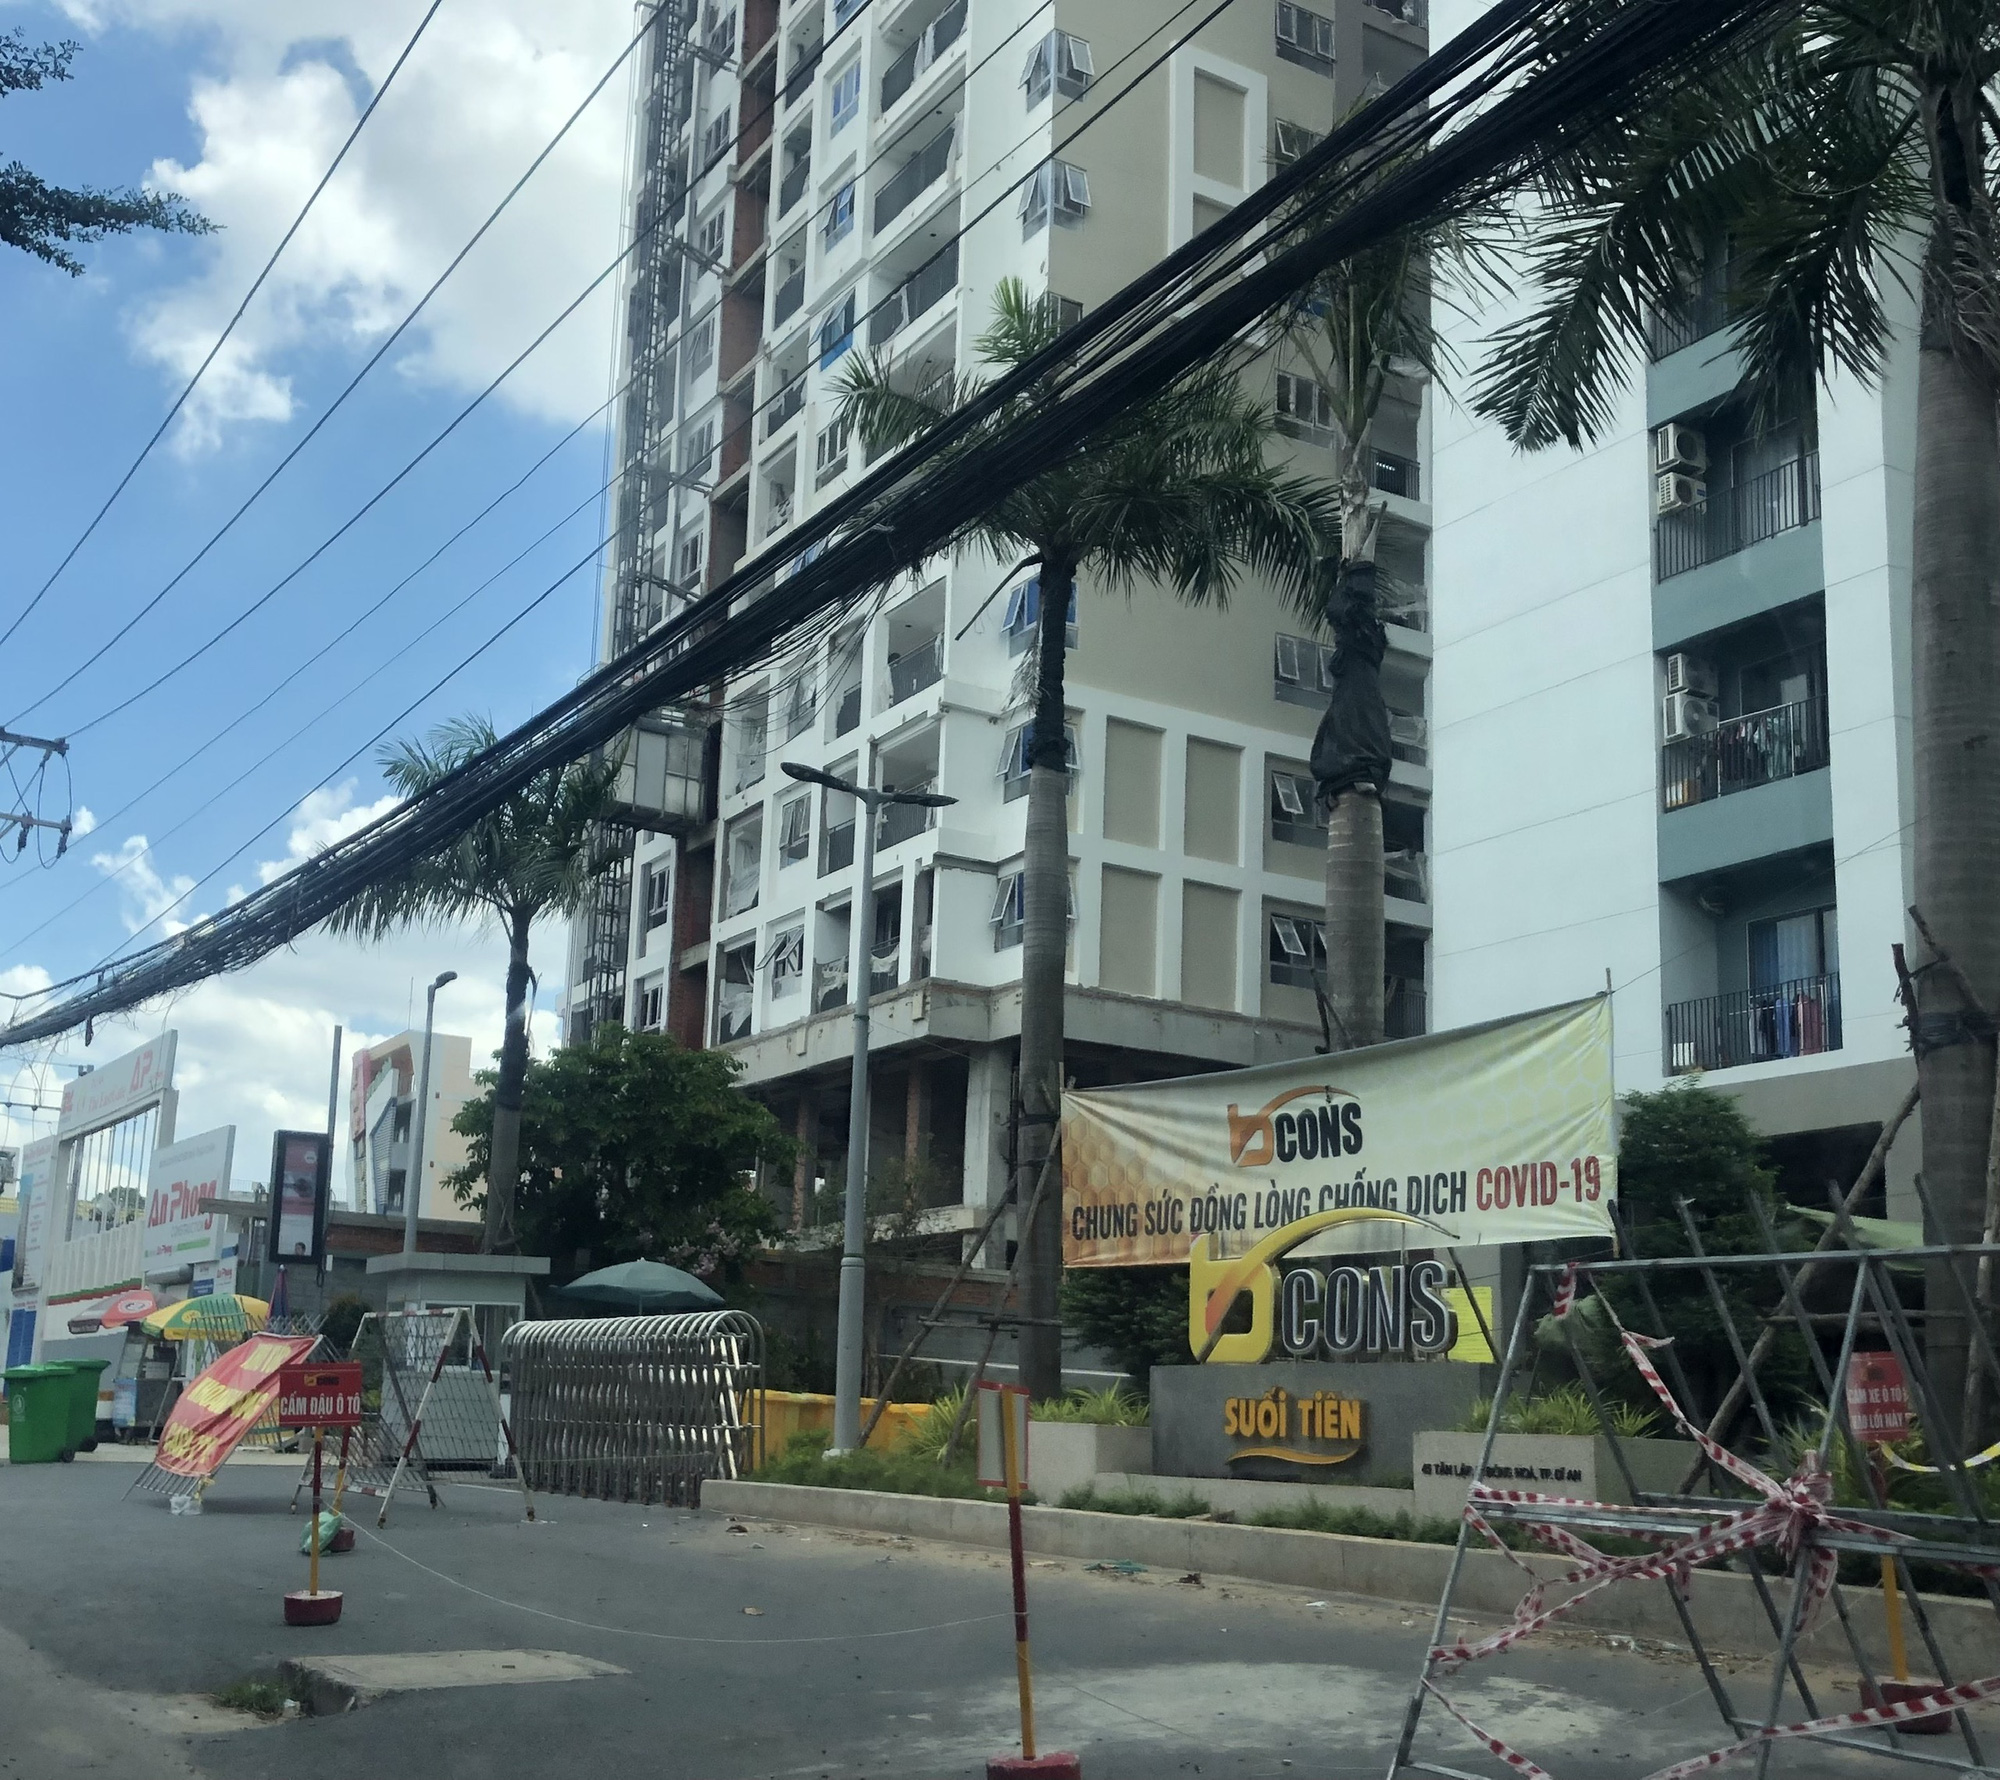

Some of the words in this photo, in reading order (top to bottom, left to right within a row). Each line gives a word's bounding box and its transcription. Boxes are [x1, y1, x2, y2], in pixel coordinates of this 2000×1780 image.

[1072, 1202, 1138, 1241] CHUNG
[1144, 1188, 1184, 1236] SỨC
[1190, 1182, 1248, 1234] ĐỒNG
[1254, 1179, 1311, 1229] LÒNG
[1318, 1167, 1398, 1212] CHỐNG
[1476, 1155, 1601, 1211] COVID-19
[281, 1391, 307, 1416] CẤM
[310, 1392, 334, 1419] ĐẬU
[336, 1392, 344, 1415] Ô
[347, 1392, 361, 1415] TÔ
